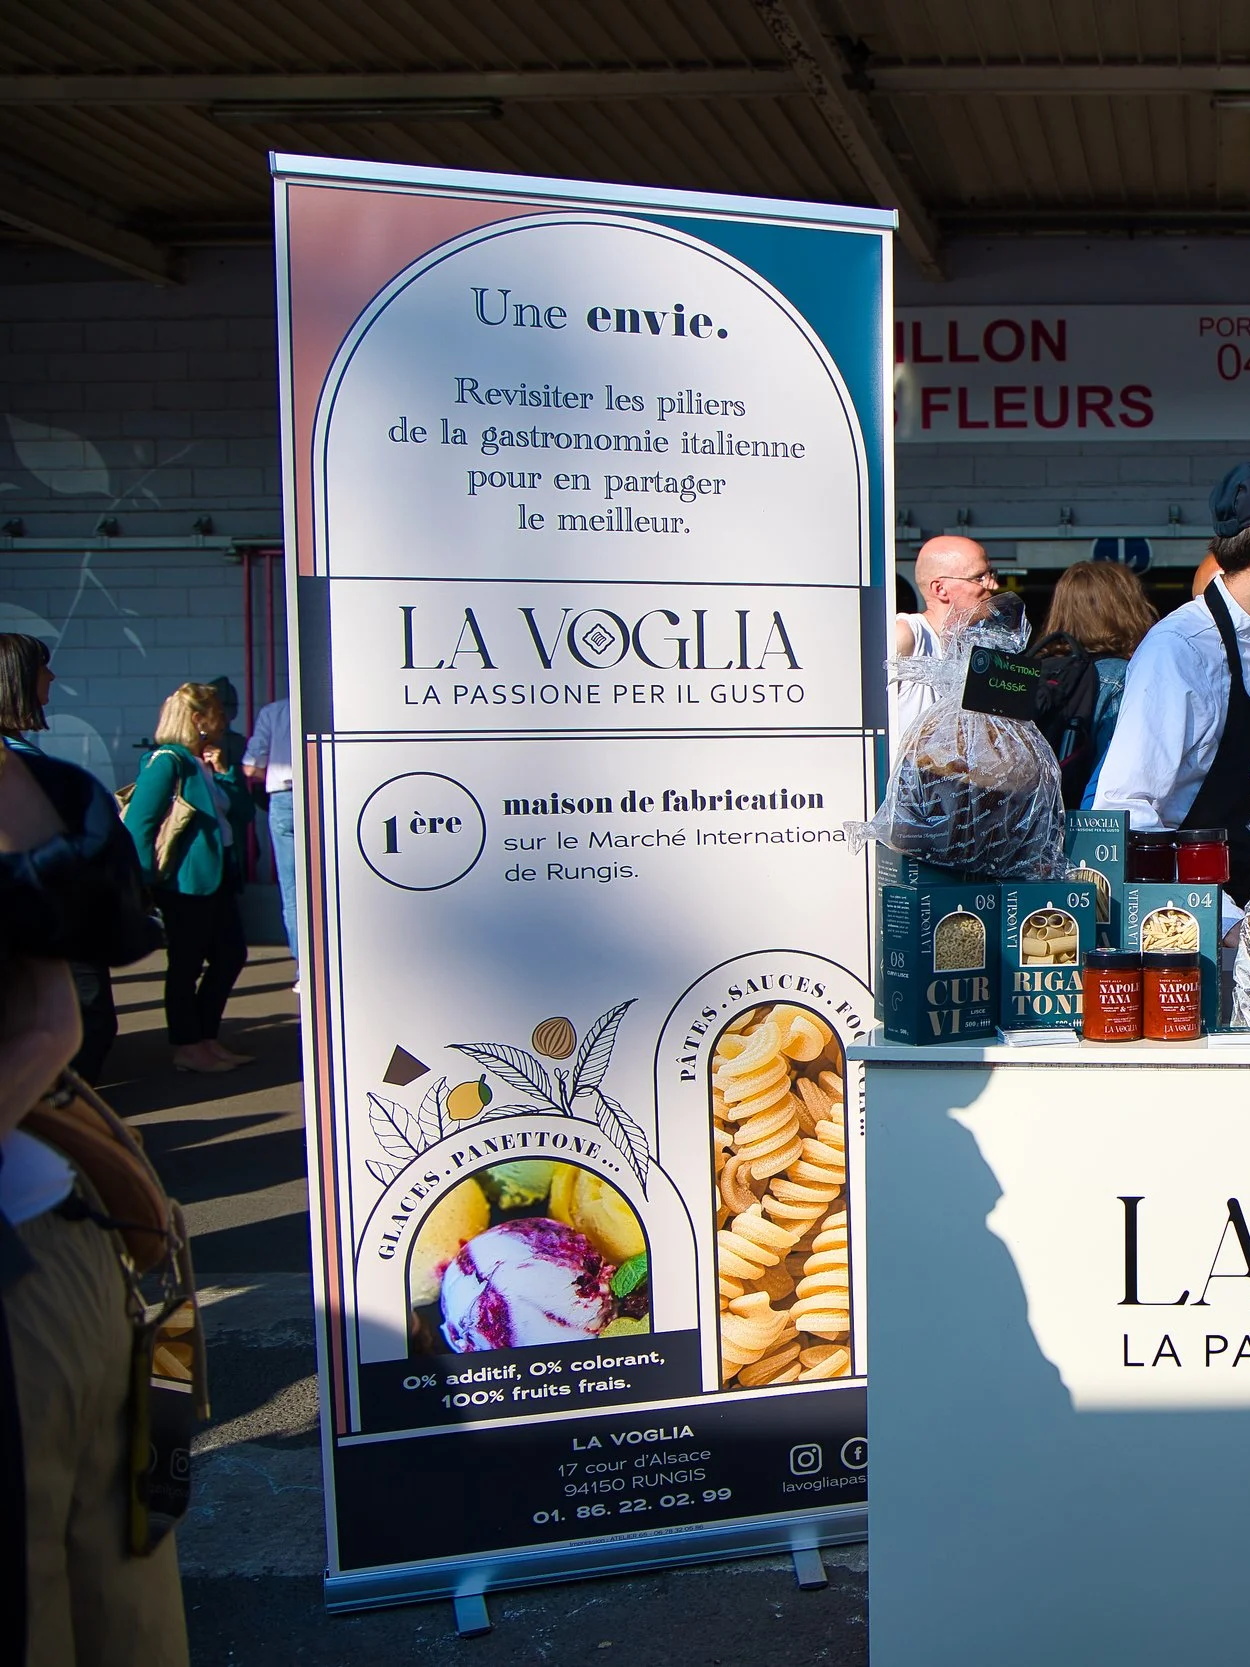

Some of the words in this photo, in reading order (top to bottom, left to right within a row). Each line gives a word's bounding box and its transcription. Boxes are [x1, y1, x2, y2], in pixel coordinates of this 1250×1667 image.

[470, 286, 568, 331] Une
[586, 303, 729, 340] envie.
[454, 376, 594, 411] Revisiter
[605, 384, 644, 413] les
[657, 386, 747, 422] piliers
[921, 384, 1155, 429] FLEURS
[388, 416, 428, 445] de
[440, 418, 468, 447] la
[481, 425, 669, 456] gastronomie
[681, 429, 806, 460] italienne
[467, 467, 542, 496] pour
[554, 470, 591, 493] en
[604, 472, 727, 503] partager
[517, 503, 546, 532] le
[558, 507, 691, 535] meilleur.
[398, 605, 498, 671] LA
[519, 606, 804, 671] VOGLIA
[404, 684, 441, 706] LA
[454, 683, 601, 706] PASSIONE
[613, 684, 665, 704] PER
[678, 684, 700, 704] IL
[710, 683, 806, 705] GUSTO
[503, 793, 612, 816] maison
[620, 790, 655, 814] de
[662, 788, 824, 813] fabrication
[1070, 818, 1081, 827] LA
[1084, 818, 1119, 828] VOGLIA
[504, 833, 546, 851] sur
[557, 827, 578, 849] le
[588, 827, 686, 848] Marché
[696, 826, 847, 845] Internationa
[1095, 844, 1119, 862] 01
[505, 862, 537, 882] de
[547, 861, 639, 884] Rungis.
[975, 894, 995, 910] 08
[1007, 891, 1018, 933] VOGLIA
[1066, 892, 1090, 908] 05
[1128, 889, 1139, 927] VOGLIA
[1187, 892, 1213, 908] 04
[920, 894, 932, 937] VOGLIA
[921, 939, 932, 954] LA
[1007, 935, 1018, 948] LA
[1128, 929, 1138, 945] LA
[890, 951, 905, 968] 08
[728, 973, 827, 1003] SAUCES
[926, 976, 991, 1006] CUR
[1013, 970, 1083, 992] RIGA
[1011, 993, 1083, 1016] TONI
[1100, 994, 1131, 1004] TANA
[1159, 993, 1190, 1004] TANA
[927, 1008, 962, 1036] VI
[1104, 1025, 1114, 1033] LA
[1164, 1025, 1174, 1033] LA
[680, 1003, 718, 1083] PÂTES
[377, 1168, 442, 1262] GLACES
[1122, 1334, 1182, 1367] LA
[402, 1372, 437, 1391] 0%
[446, 1363, 523, 1386] additif,
[529, 1359, 562, 1377] 0%
[570, 1351, 666, 1373] colorant,
[442, 1389, 505, 1409] 100%
[512, 1381, 572, 1401] fruits
[578, 1375, 632, 1395] frais.
[573, 1436, 602, 1451] LA
[610, 1425, 695, 1446] VOGLIA
[558, 1463, 578, 1477] 17
[585, 1458, 628, 1475] cour
[633, 1447, 712, 1471] d'Alsace
[564, 1478, 625, 1497] 94150
[632, 1467, 707, 1489] RUNGIS
[783, 1475, 868, 1494] lavogliapas
[533, 1509, 566, 1525] 01.
[576, 1504, 611, 1519] 86.
[620, 1499, 653, 1515] 22.
[659, 1493, 695, 1509] 02.
[702, 1487, 732, 1503] 99
